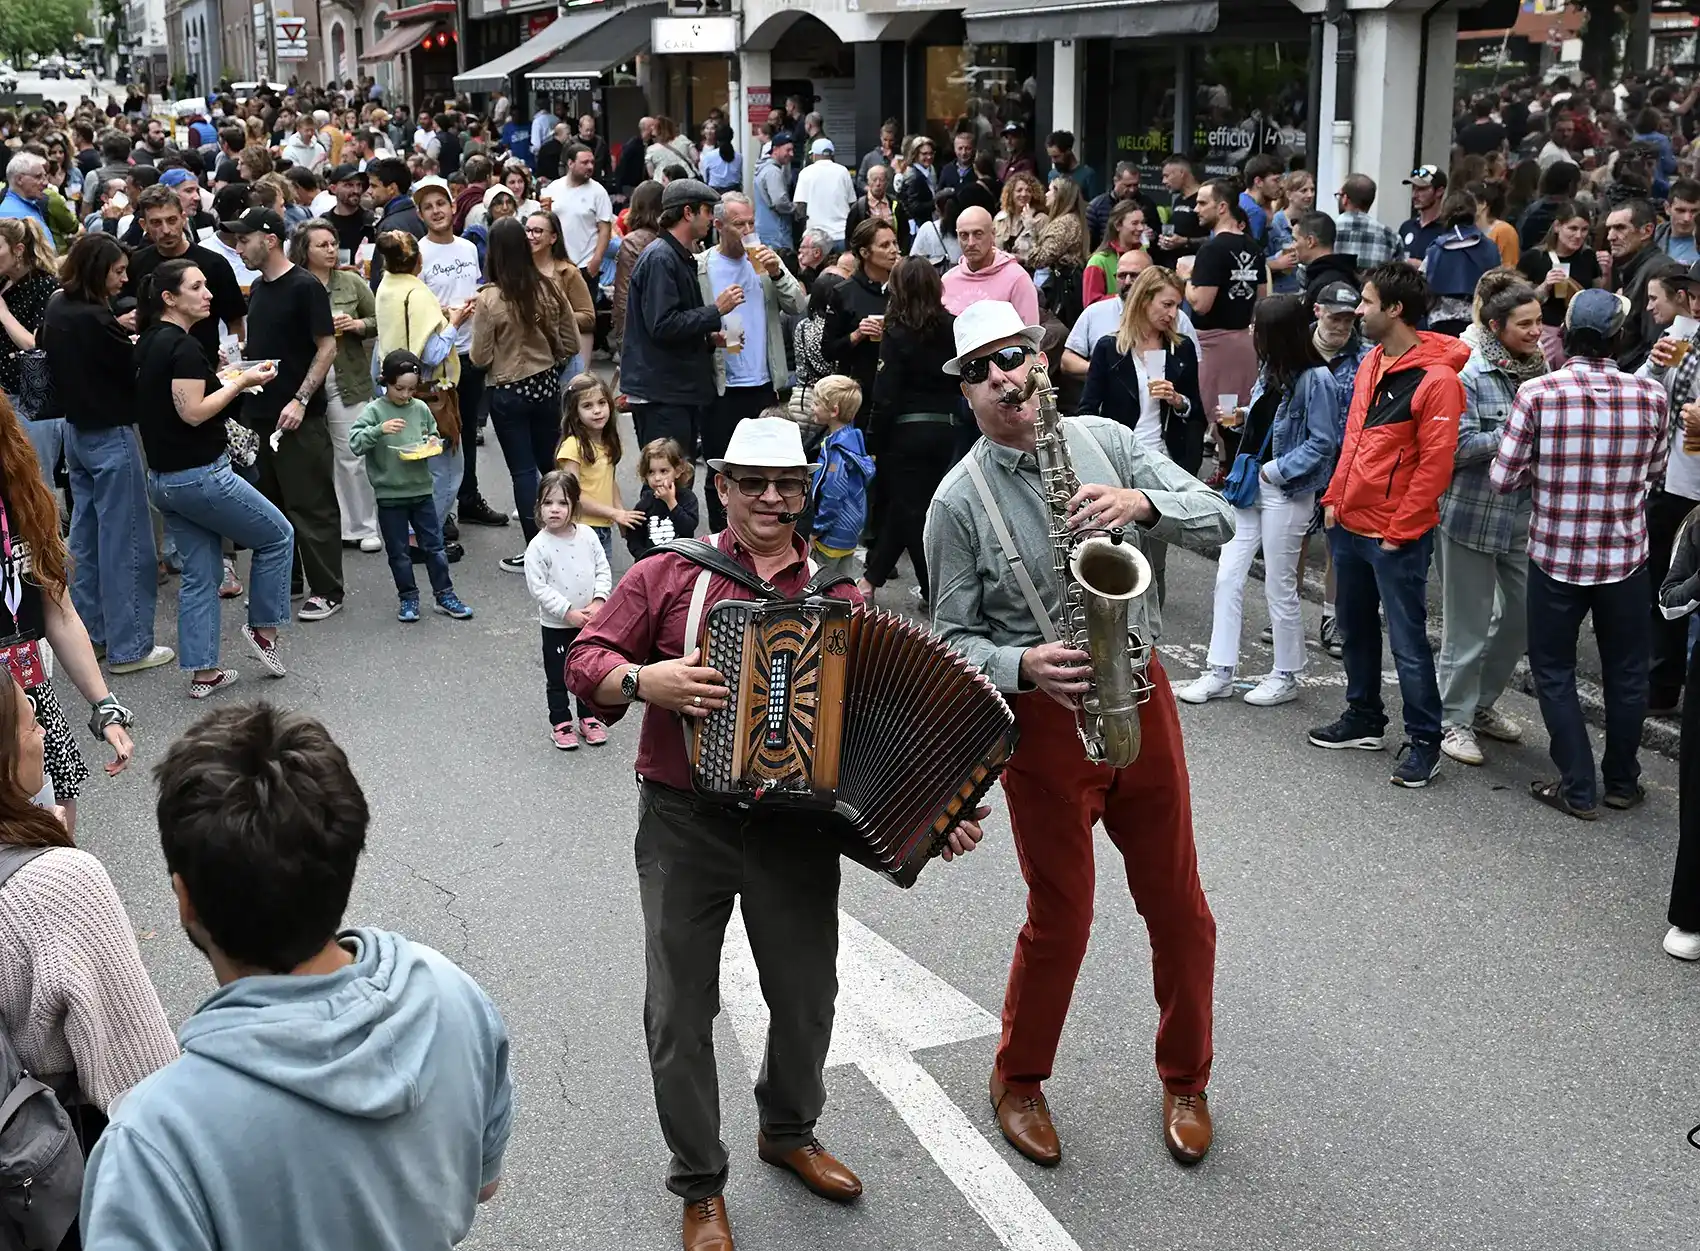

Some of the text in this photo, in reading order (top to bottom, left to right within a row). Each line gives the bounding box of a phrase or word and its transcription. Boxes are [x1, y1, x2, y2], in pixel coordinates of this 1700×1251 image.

[1116, 135, 1168, 152] WELCOME
[1208, 126, 1255, 148] efficity
[1205, 165, 1238, 175] IMMOBILIER
[432, 263, 455, 276] Pepe
